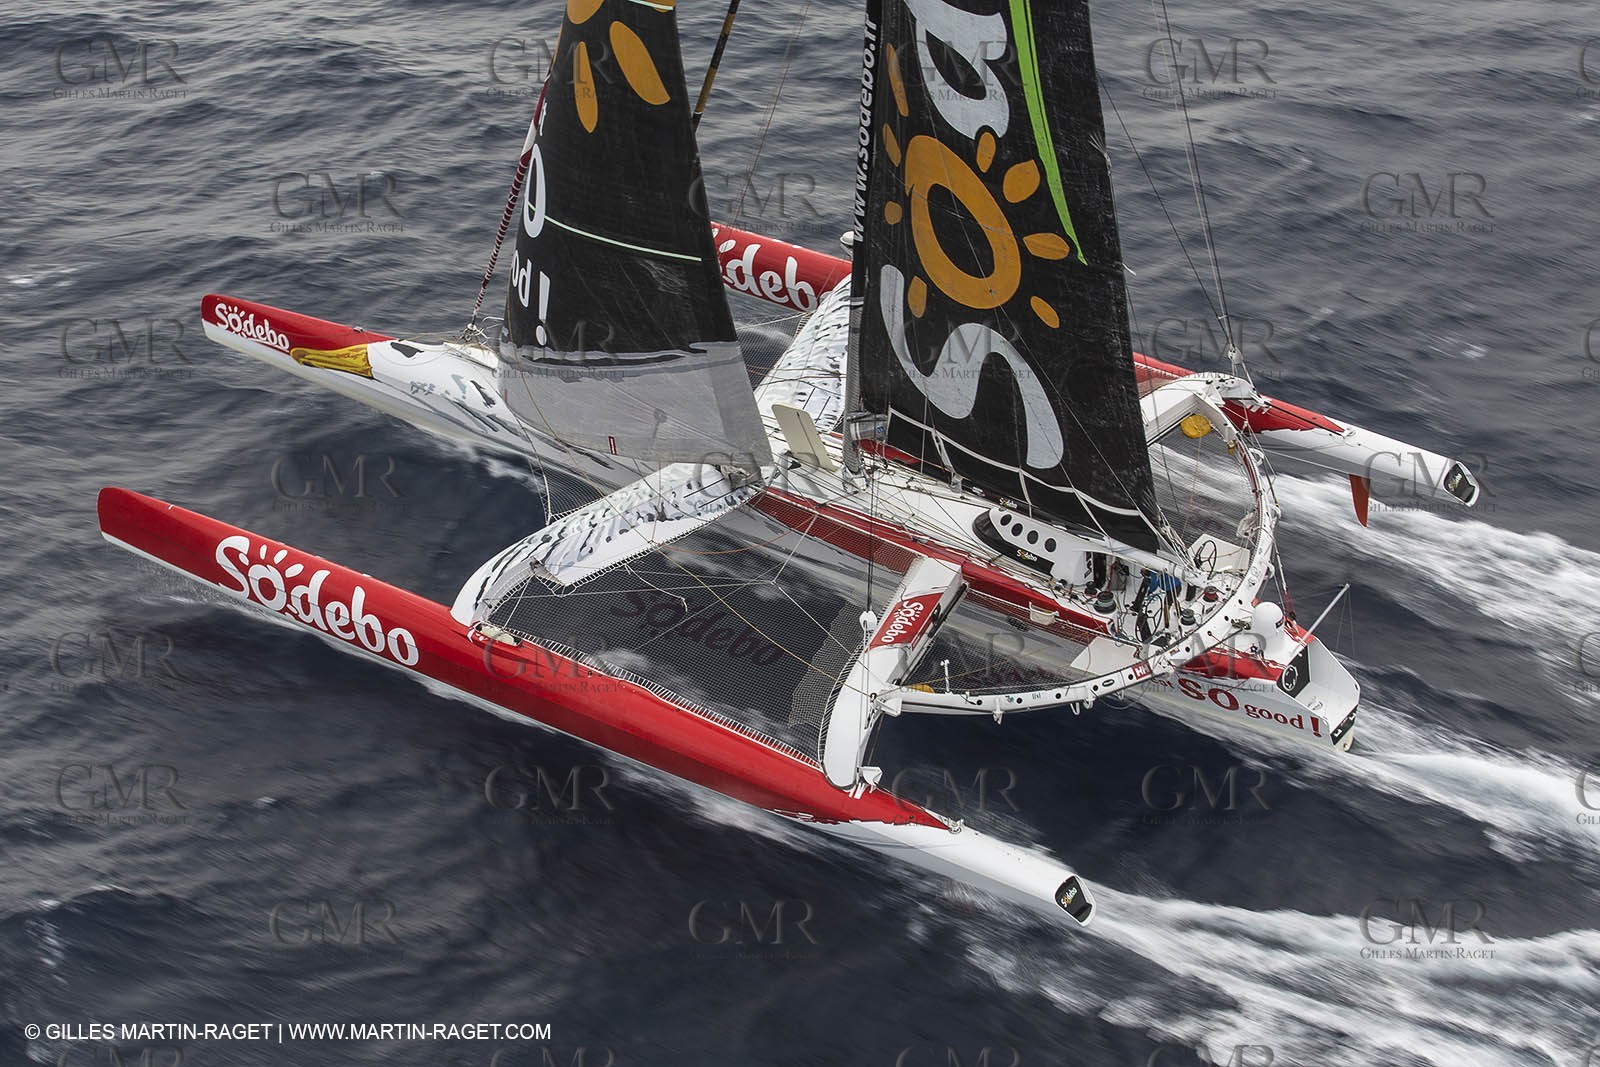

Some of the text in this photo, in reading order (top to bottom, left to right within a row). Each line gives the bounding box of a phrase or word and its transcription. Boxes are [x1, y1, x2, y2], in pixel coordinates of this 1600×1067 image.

[853, 14, 878, 244] www.sodebo.fr
[215, 303, 290, 351] Sodebo
[215, 535, 420, 667] Sodebo
[881, 600, 925, 643] Sodebo
[1243, 703, 1305, 730] good
